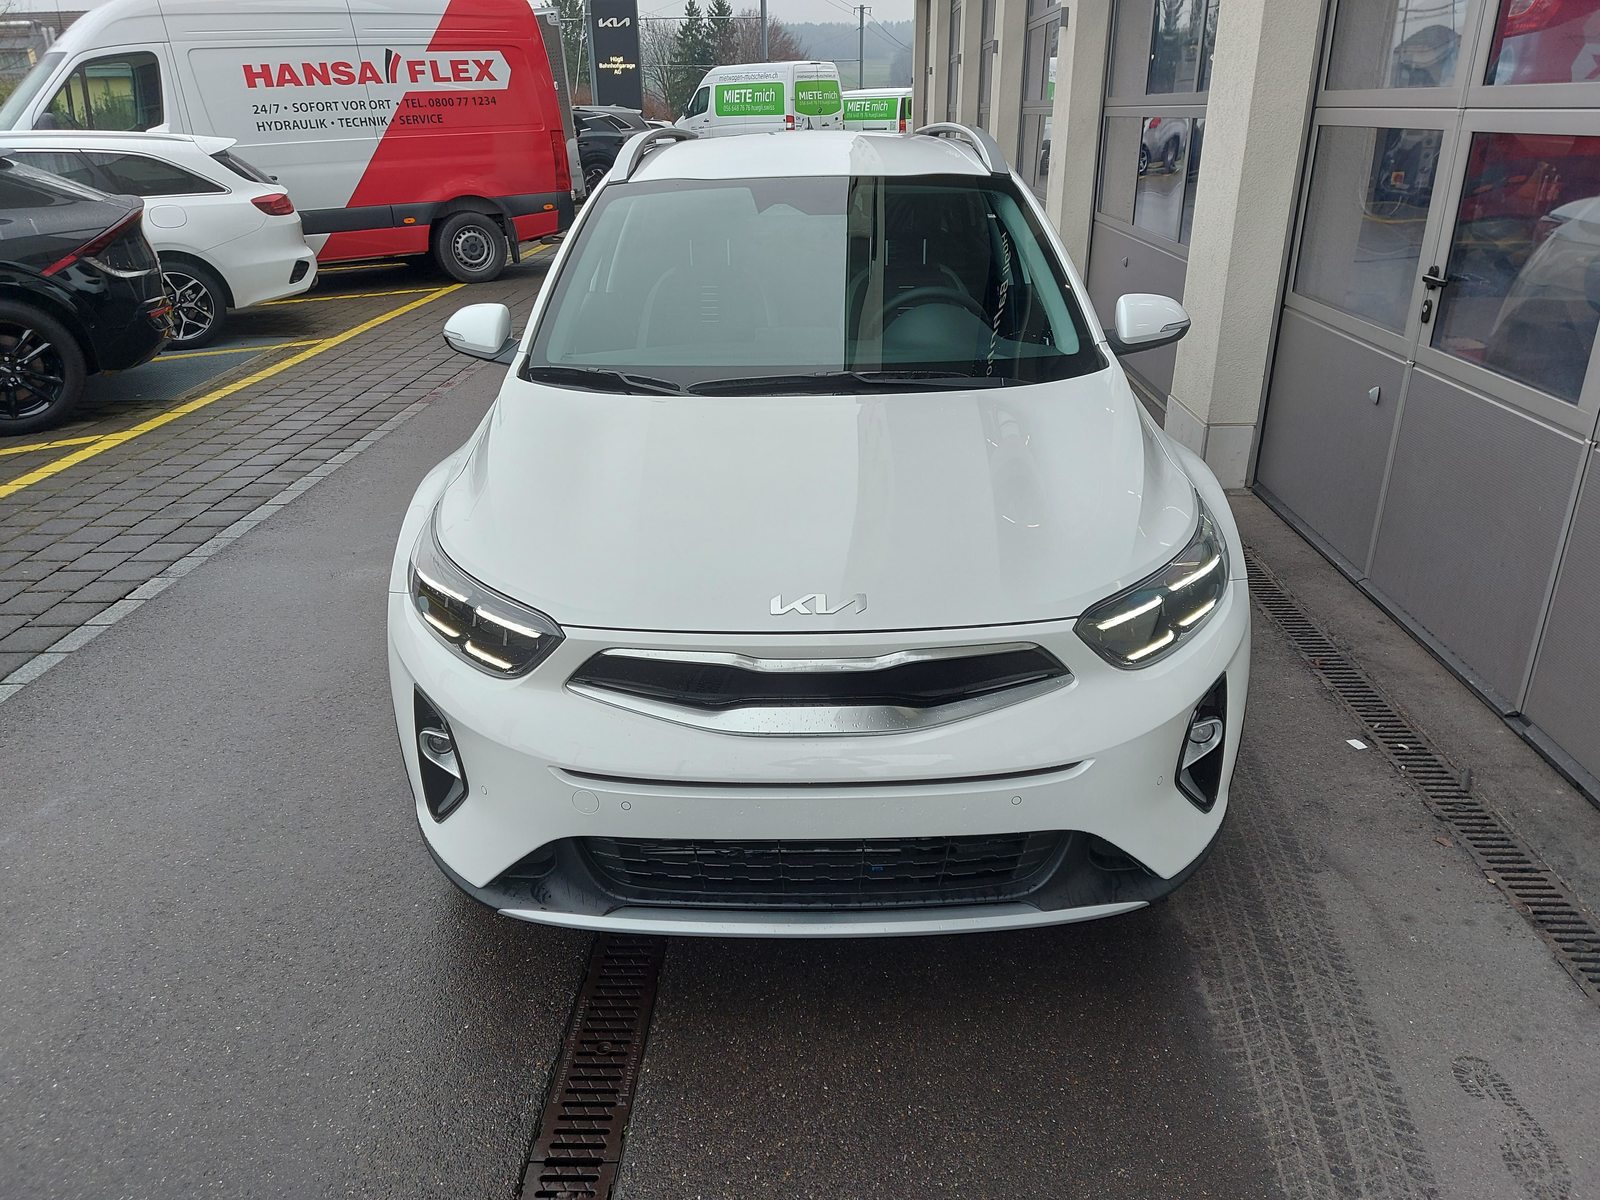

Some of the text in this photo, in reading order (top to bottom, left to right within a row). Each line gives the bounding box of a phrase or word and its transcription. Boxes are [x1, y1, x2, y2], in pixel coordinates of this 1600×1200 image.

[598, 17, 631, 27] KIA
[242, 59, 498, 88] HANSA FLEX
[723, 88, 776, 103] MIETE mich
[798, 91, 838, 100] MIETE mich
[252, 96, 497, 115] 24/7 SOFORT VOR ORT TEL. 0800 77 1234
[846, 100, 889, 112] MIETE mich
[256, 113, 443, 132] HYDRAULIK TECHNIK SERVICE
[770, 593, 867, 615] KIA
